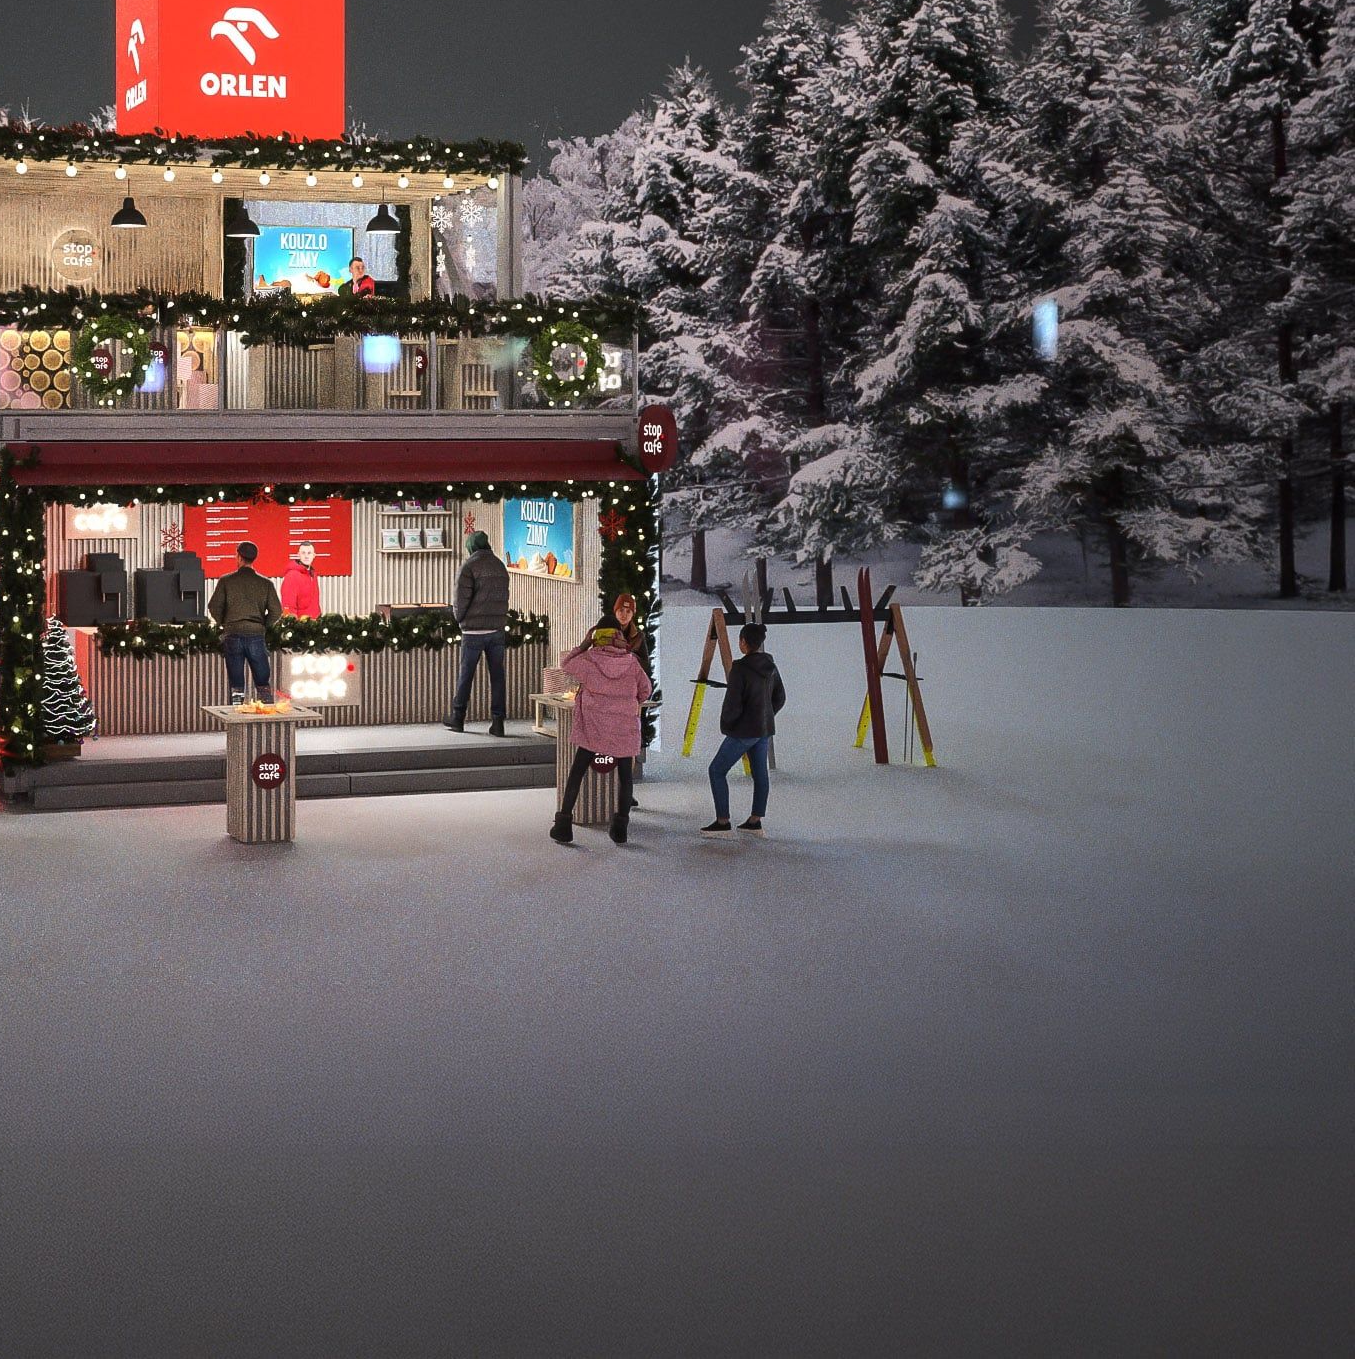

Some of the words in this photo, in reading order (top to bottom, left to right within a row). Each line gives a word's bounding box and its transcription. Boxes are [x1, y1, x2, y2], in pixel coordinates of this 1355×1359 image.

[200, 72, 287, 98] ORLEN
[125, 78, 147, 112] ORLEN
[280, 232, 328, 251] KOUZLO
[63, 254, 93, 267] cafe
[288, 250, 319, 268] ZIMY
[643, 439, 662, 455] cafe
[520, 500, 555, 524] KOUZLO
[526, 523, 549, 547] ZIMY
[291, 676, 346, 701] cafe
[594, 756, 614, 765] cafe
[259, 771, 280, 781] cafe
